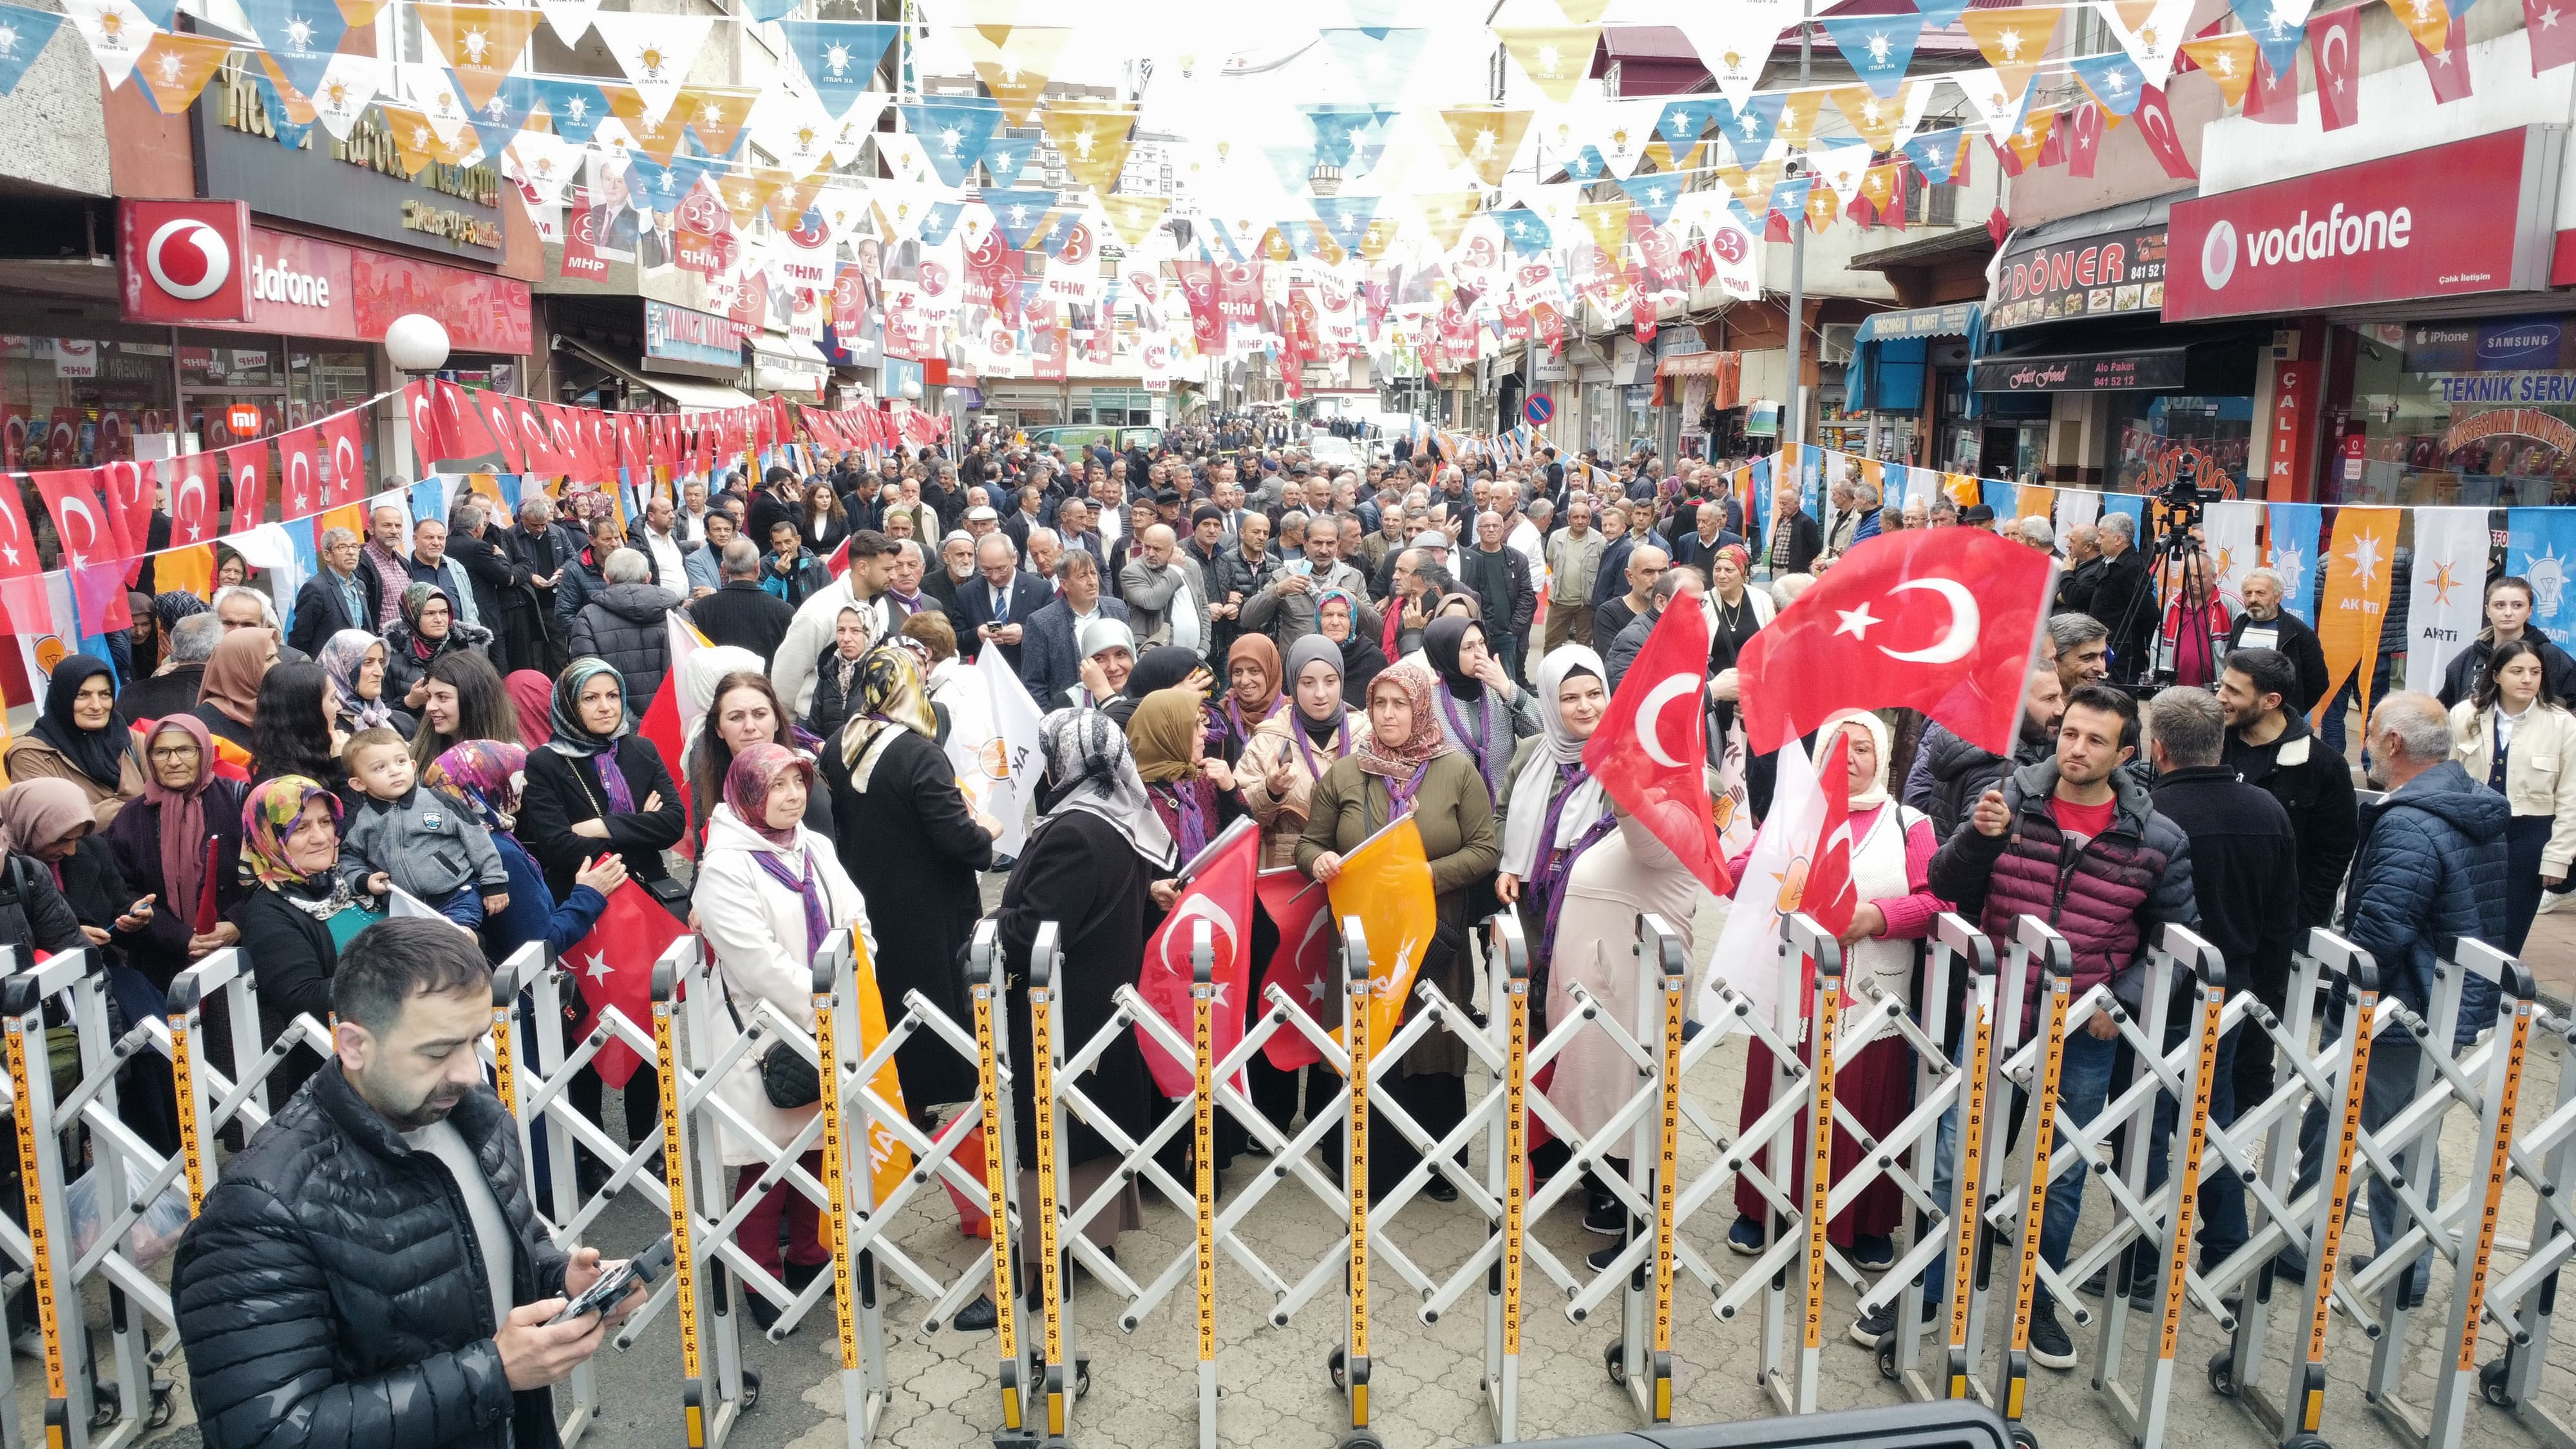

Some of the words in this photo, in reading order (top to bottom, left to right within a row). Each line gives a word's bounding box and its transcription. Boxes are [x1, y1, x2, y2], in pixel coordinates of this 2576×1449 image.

[252, 253, 330, 308] dafone
[568, 258, 605, 271] MHP
[1526, 290, 1557, 303] MHP
[2011, 243, 2125, 300] DÖNER
[2131, 265, 2146, 280] 841
[2148, 264, 2159, 276] 52
[2247, 203, 2411, 267] vodafone
[2439, 275, 2459, 285] Çalık
[2460, 272, 2490, 283] İletişim
[730, 323, 757, 334] MHP
[888, 346, 910, 355] MHP
[919, 308, 947, 321] MHP
[988, 365, 1010, 375] MHP
[1037, 368, 1061, 378] MHP
[1147, 381, 1167, 389] MHP
[1237, 339, 1262, 349] MHP
[1448, 339, 1474, 349] MHP
[1508, 325, 1527, 336] MHP
[2010, 367, 2036, 388] Fast
[2036, 365, 2068, 387] Food
[2094, 376, 2108, 386] 841
[2110, 376, 2123, 386] 52
[2124, 375, 2135, 385] 12
[2095, 363, 2108, 372] Alo
[2110, 361, 2135, 371] Paket
[2430, 330, 2468, 343] iPhone
[2488, 334, 2548, 348] SAMSUNG
[2274, 372, 2297, 476] ÇALIK
[2441, 374, 2517, 403] TEKNİK
[2448, 408, 2515, 455] AKSESUAR
[2517, 407, 2575, 455] DÜNYASI
[2340, 598, 2360, 610] AK
[175, 1038, 202, 1203] VAKFIKEBİR
[1036, 1010, 1051, 1173] VAKFIKEBİR
[1197, 1007, 1208, 1170] VAKFIKEBİR
[1354, 1001, 1364, 1165] VAKFIKEBİR
[1510, 1001, 1523, 1164] VAKFIKEBİR
[1663, 998, 1678, 1160] VAKFIKEBİR
[1817, 998, 1837, 1159] VAKFIKEBİR
[1968, 1030, 1987, 1159] KFIKEBİR
[2036, 999, 2065, 1162] VAKFIKEBİR
[2188, 1009, 2218, 1171] VAKFIKEBİR
[2338, 1013, 2371, 1175] VAKFIKEBİR
[2491, 1022, 2526, 1184] VAKFIKEBİR
[8, 1039, 39, 1204] VAKFIKEBİR
[33, 1229, 60, 1388] BELEDİYESİ
[658, 1024, 681, 1186] VAKFIKEBİR
[674, 1210, 695, 1368] BELEDİYESİ
[819, 1016, 839, 1179] VAKFIKEBİR
[832, 1203, 852, 1361] BELEDİYESİ
[978, 1007, 998, 1169] VAKFIKEBİR
[991, 1193, 1010, 1350] BELEDİYESİ
[1043, 1198, 1056, 1355] BELEDİYESİ
[1200, 1193, 1210, 1352] BELEDİYESİ
[1354, 1189, 1364, 1347] BELEDİYESİ
[1508, 1188, 1519, 1346] BELEDİYESİ
[1660, 1184, 1671, 1341] BELEDİYESİ
[1809, 1182, 1824, 1339] BELEDİYESİ
[1955, 1181, 1975, 1336] BELEDİYESİ
[2016, 1185, 2041, 1341] BELEDİYESİ
[2164, 1194, 2192, 1350] BELEDİYESİ
[2313, 1197, 2342, 1352] BELEDİYESİ
[2463, 1206, 2495, 1361] BELEDİYESİ
